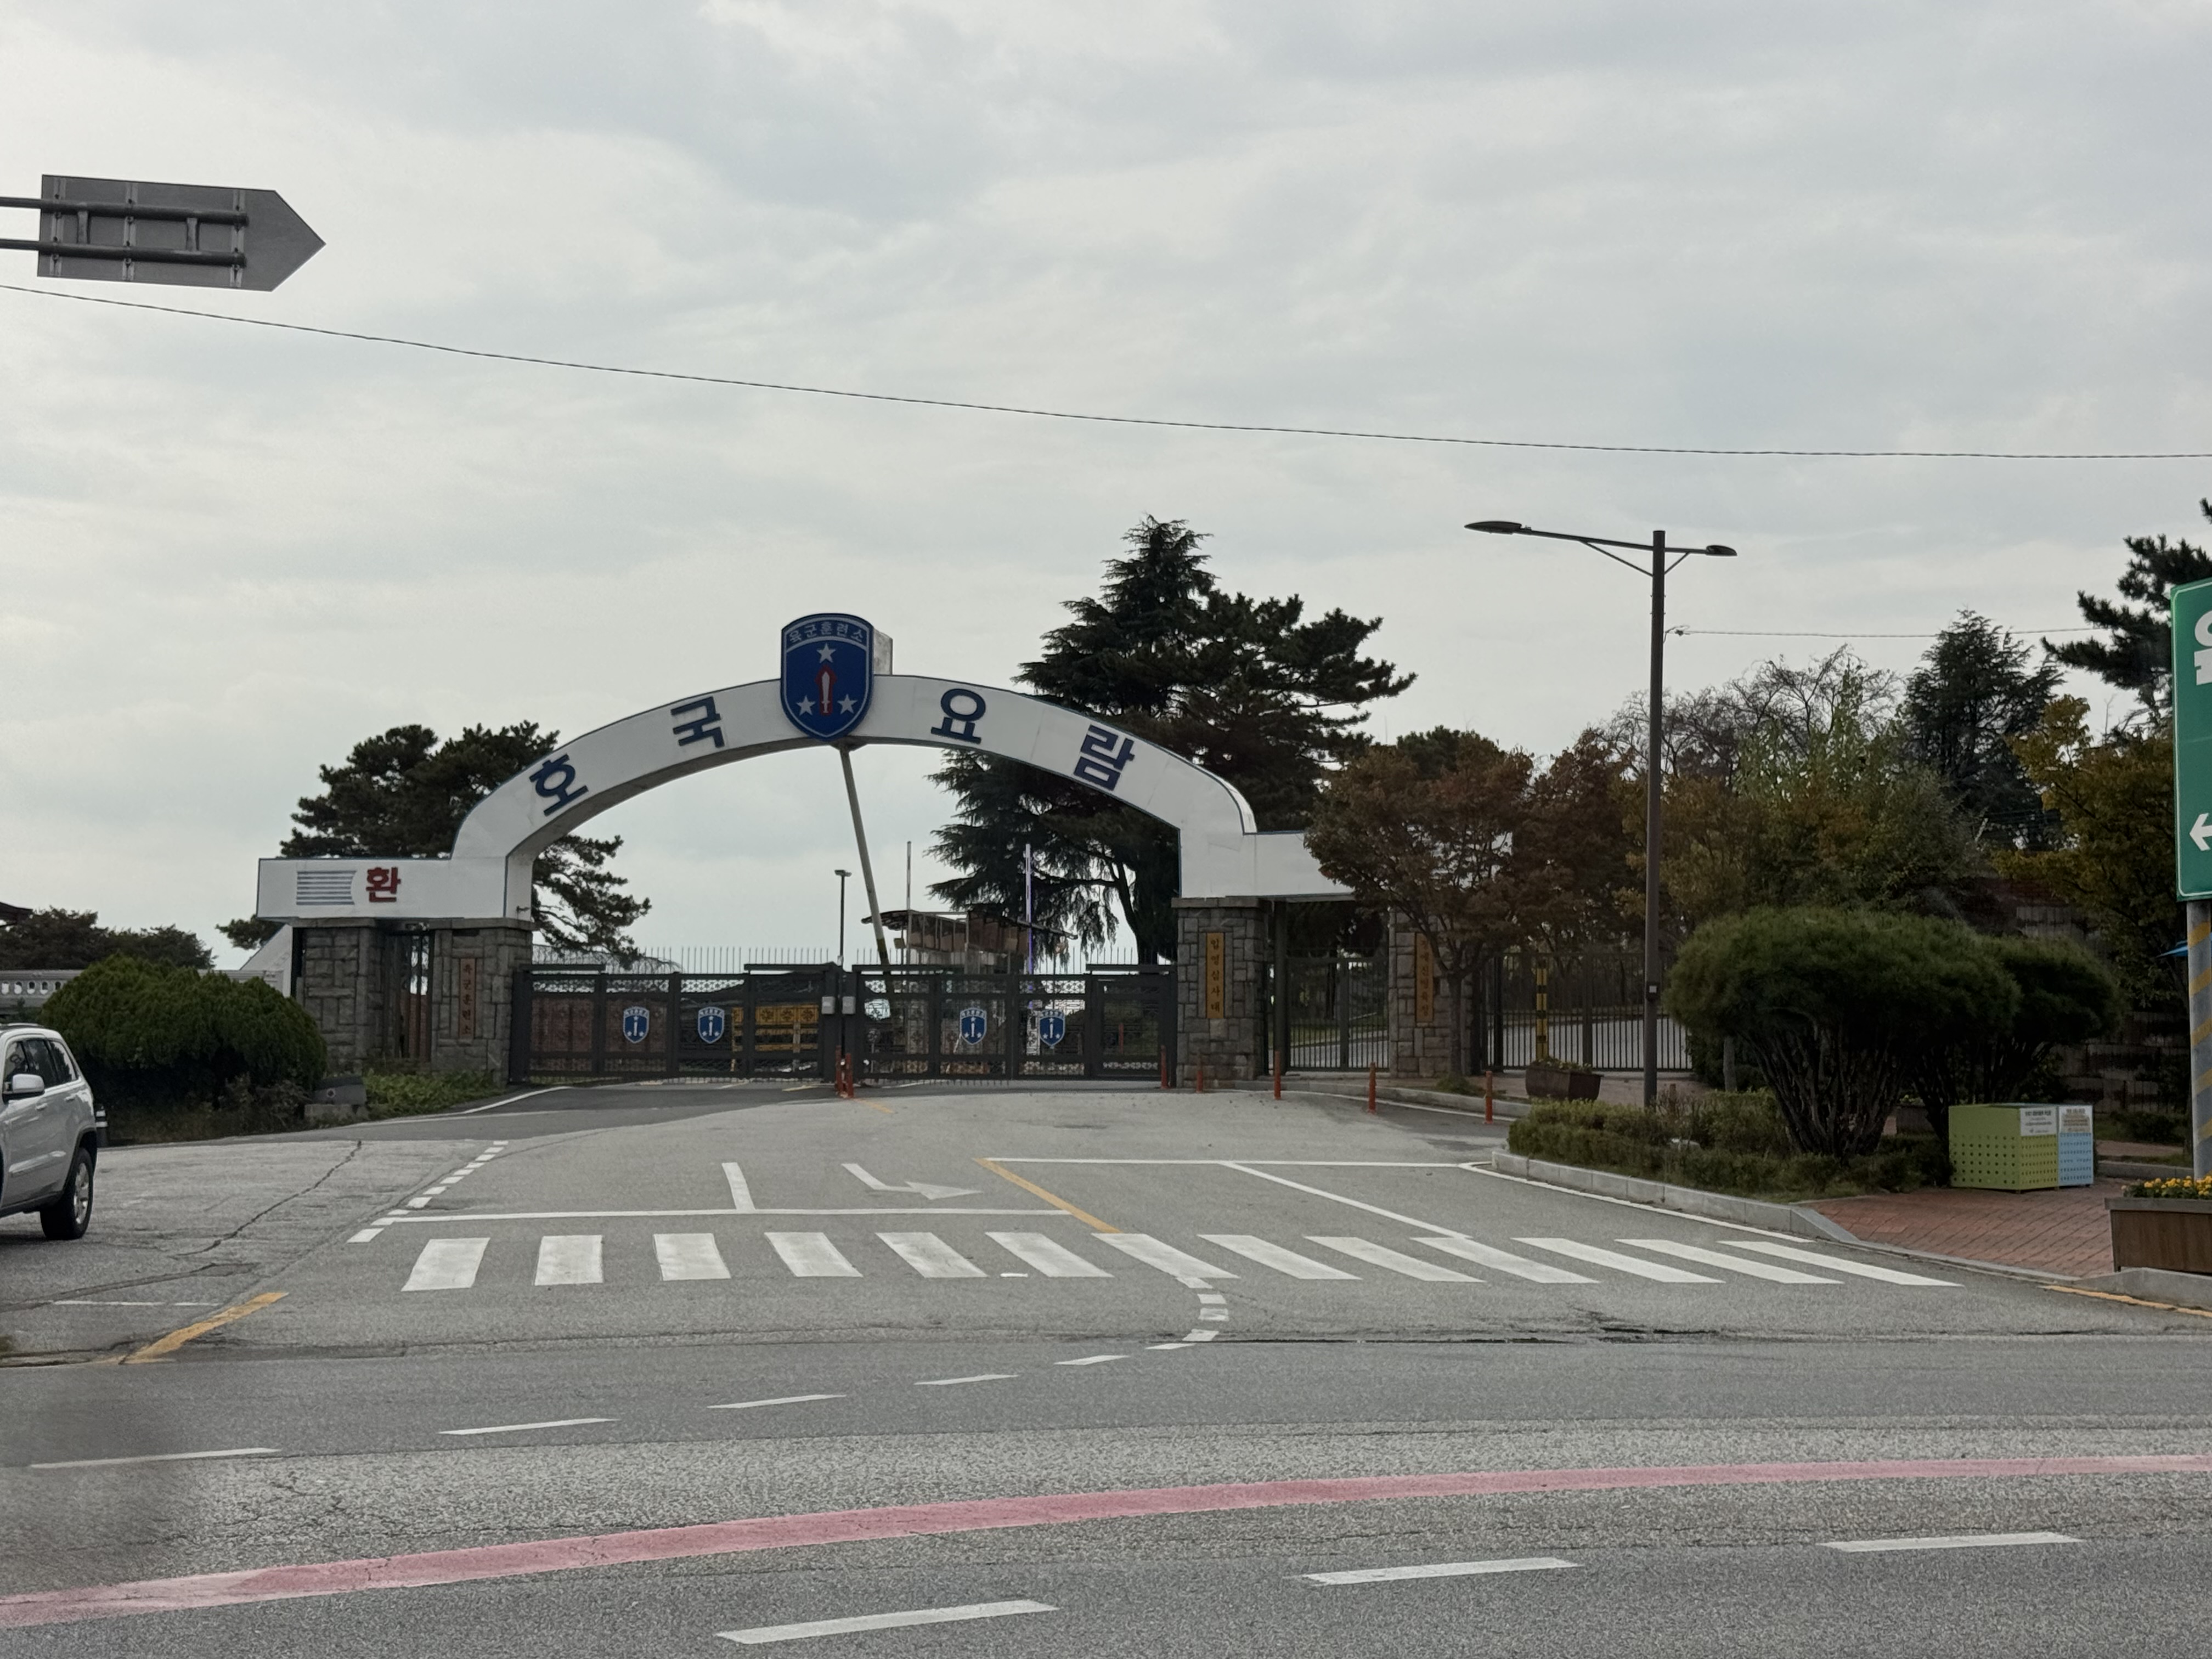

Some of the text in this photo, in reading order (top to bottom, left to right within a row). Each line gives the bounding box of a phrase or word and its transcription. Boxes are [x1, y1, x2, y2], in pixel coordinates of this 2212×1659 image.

[789, 621, 864, 643] 육군훈련소
[365, 867, 402, 902] 환
[1210, 938, 1221, 1013] 입영심사대
